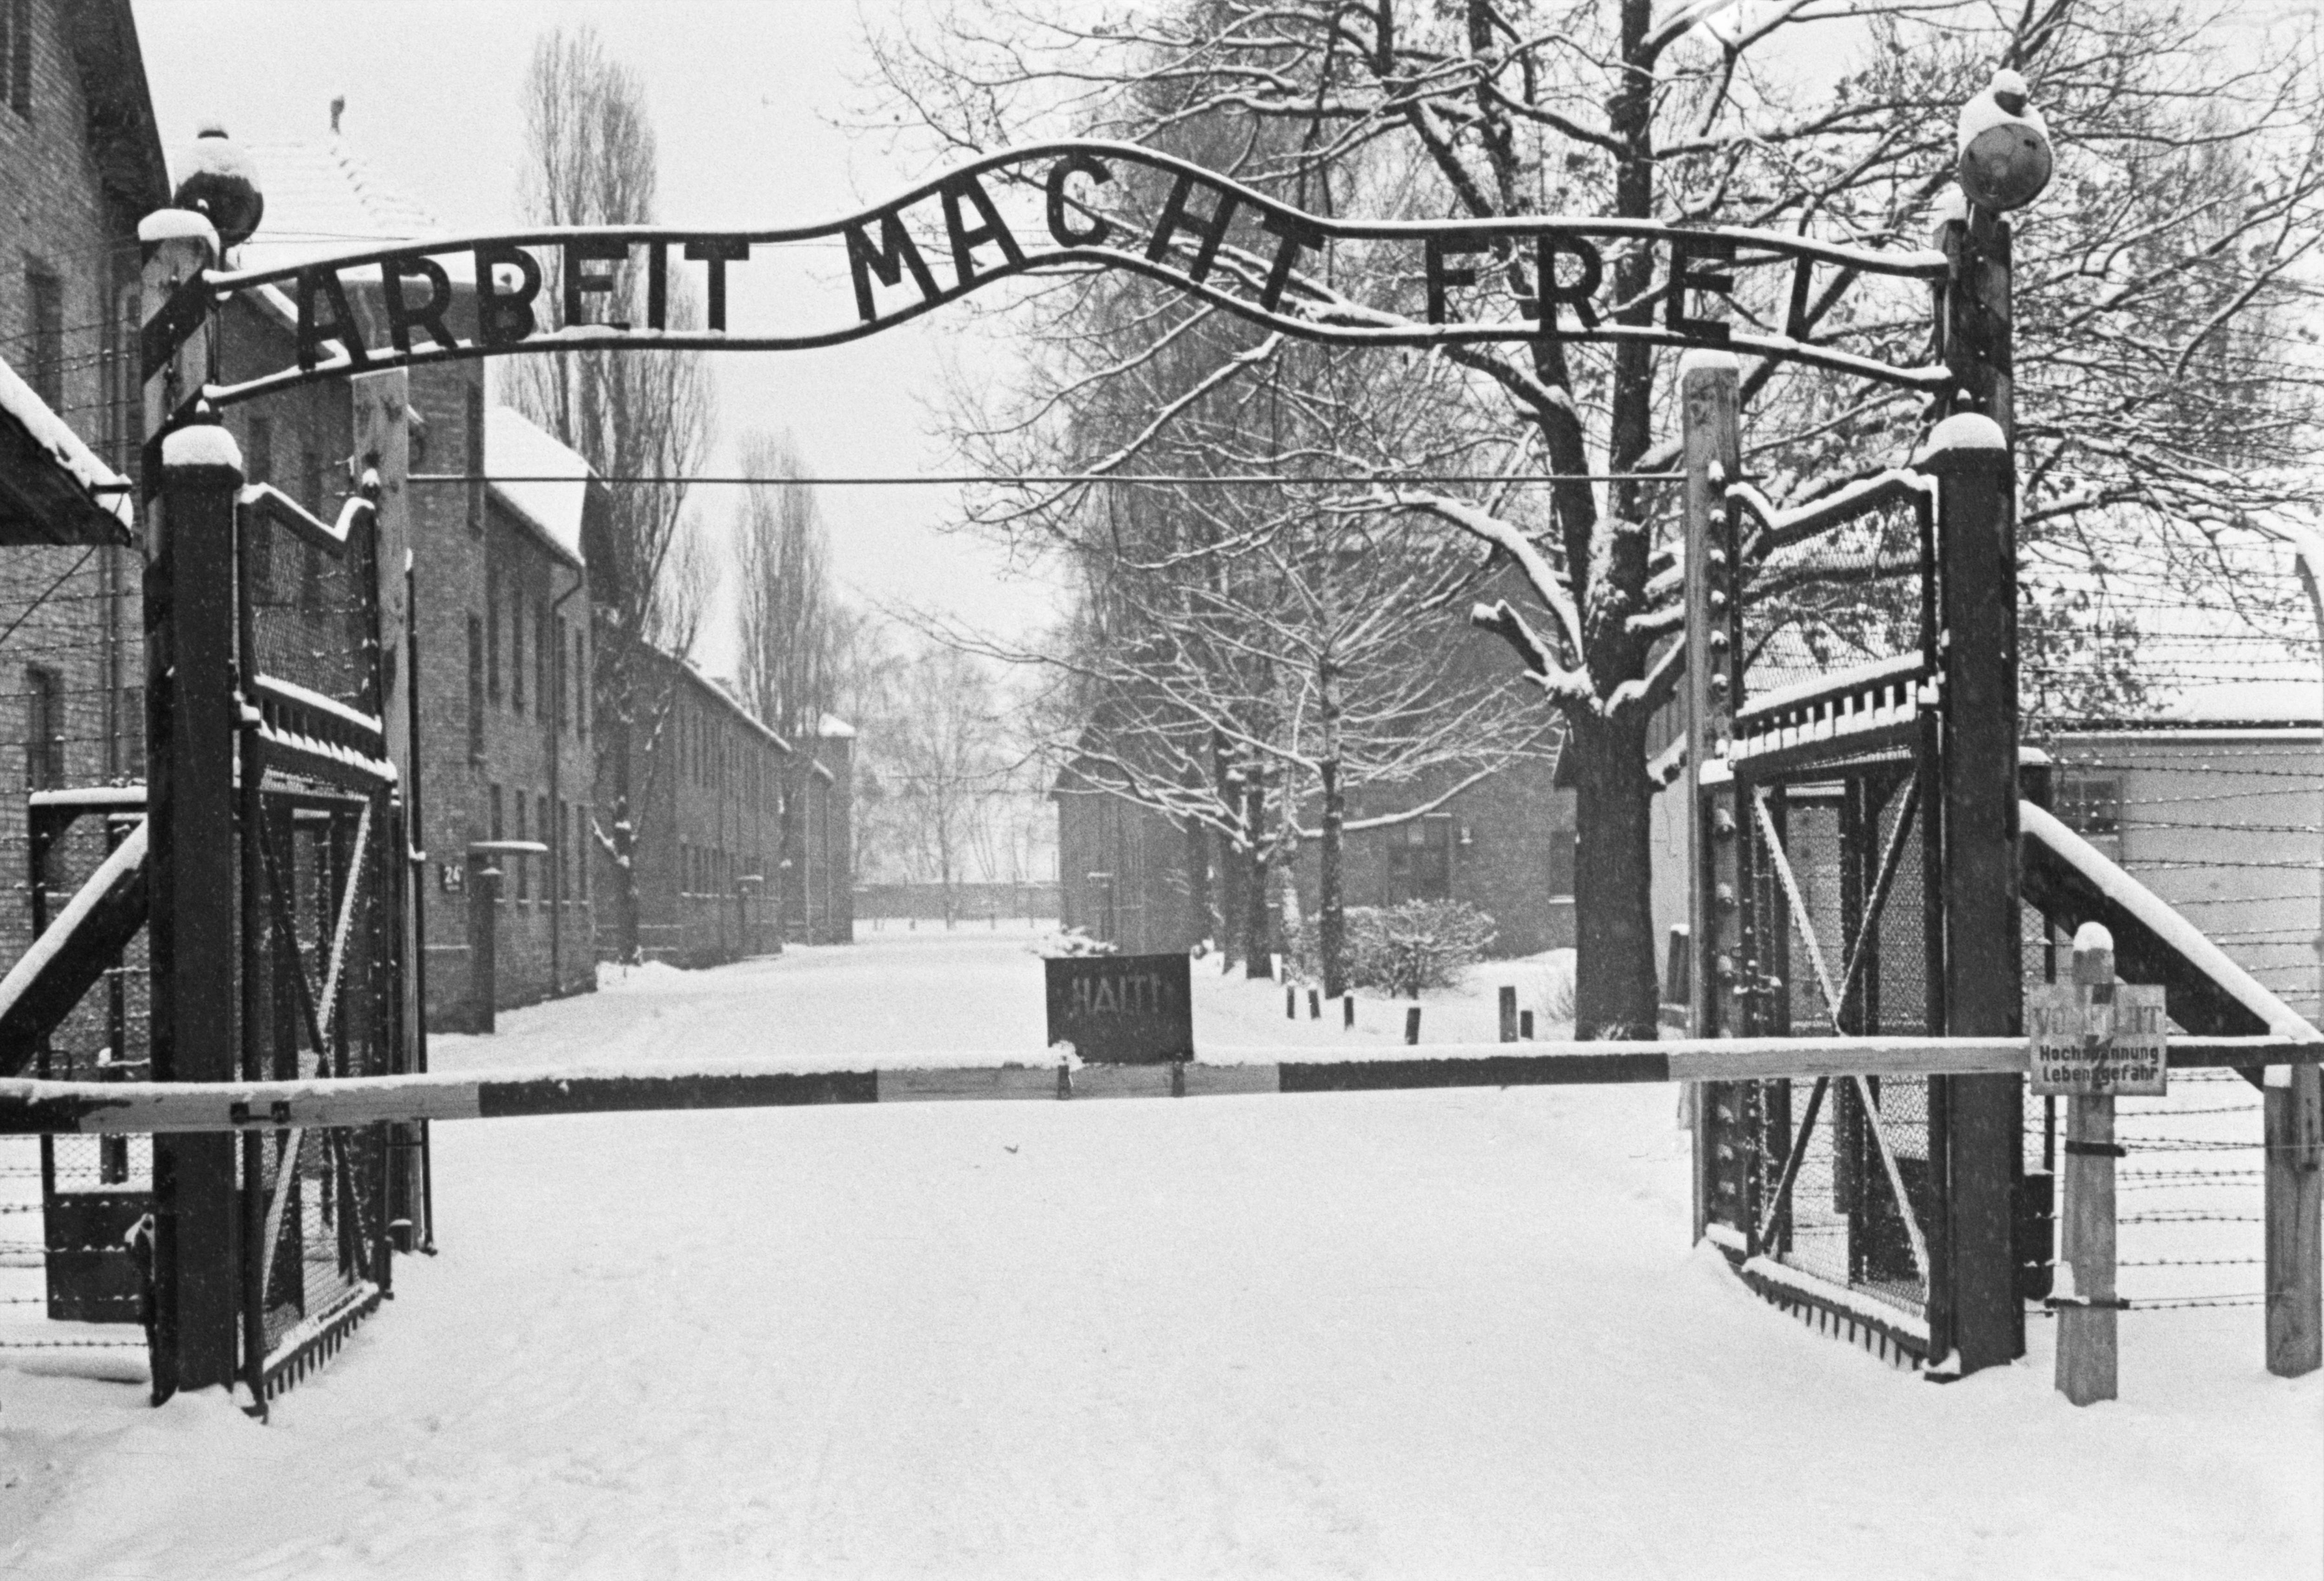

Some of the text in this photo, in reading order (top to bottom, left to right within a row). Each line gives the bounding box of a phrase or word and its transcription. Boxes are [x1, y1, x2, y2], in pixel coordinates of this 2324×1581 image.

[295, 151, 1814, 372] ARBEIT MACHT FREI
